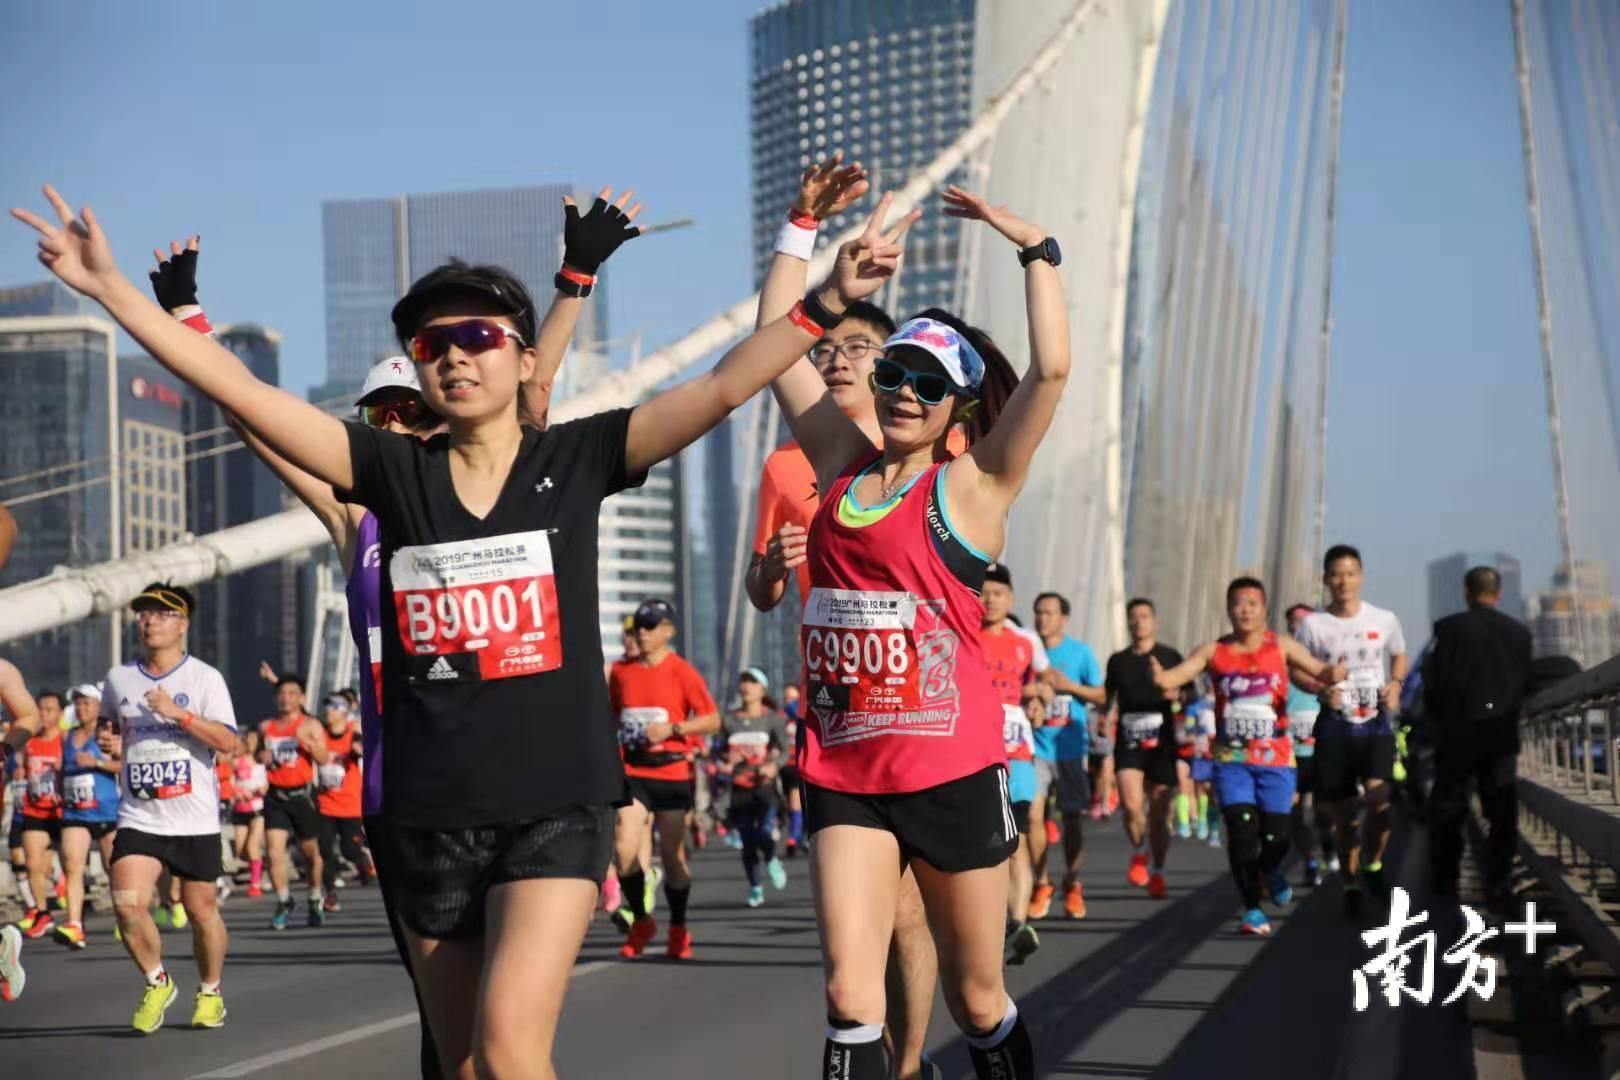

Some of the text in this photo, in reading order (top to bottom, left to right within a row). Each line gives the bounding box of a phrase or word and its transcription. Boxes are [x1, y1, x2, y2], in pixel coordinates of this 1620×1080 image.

[405, 580, 544, 641] B9001
[806, 629, 909, 674] C9908
[427, 670, 459, 680] adidas
[867, 712, 897, 727] KEEP
[898, 708, 951, 725] RUNNING
[130, 761, 187, 784] B2042
